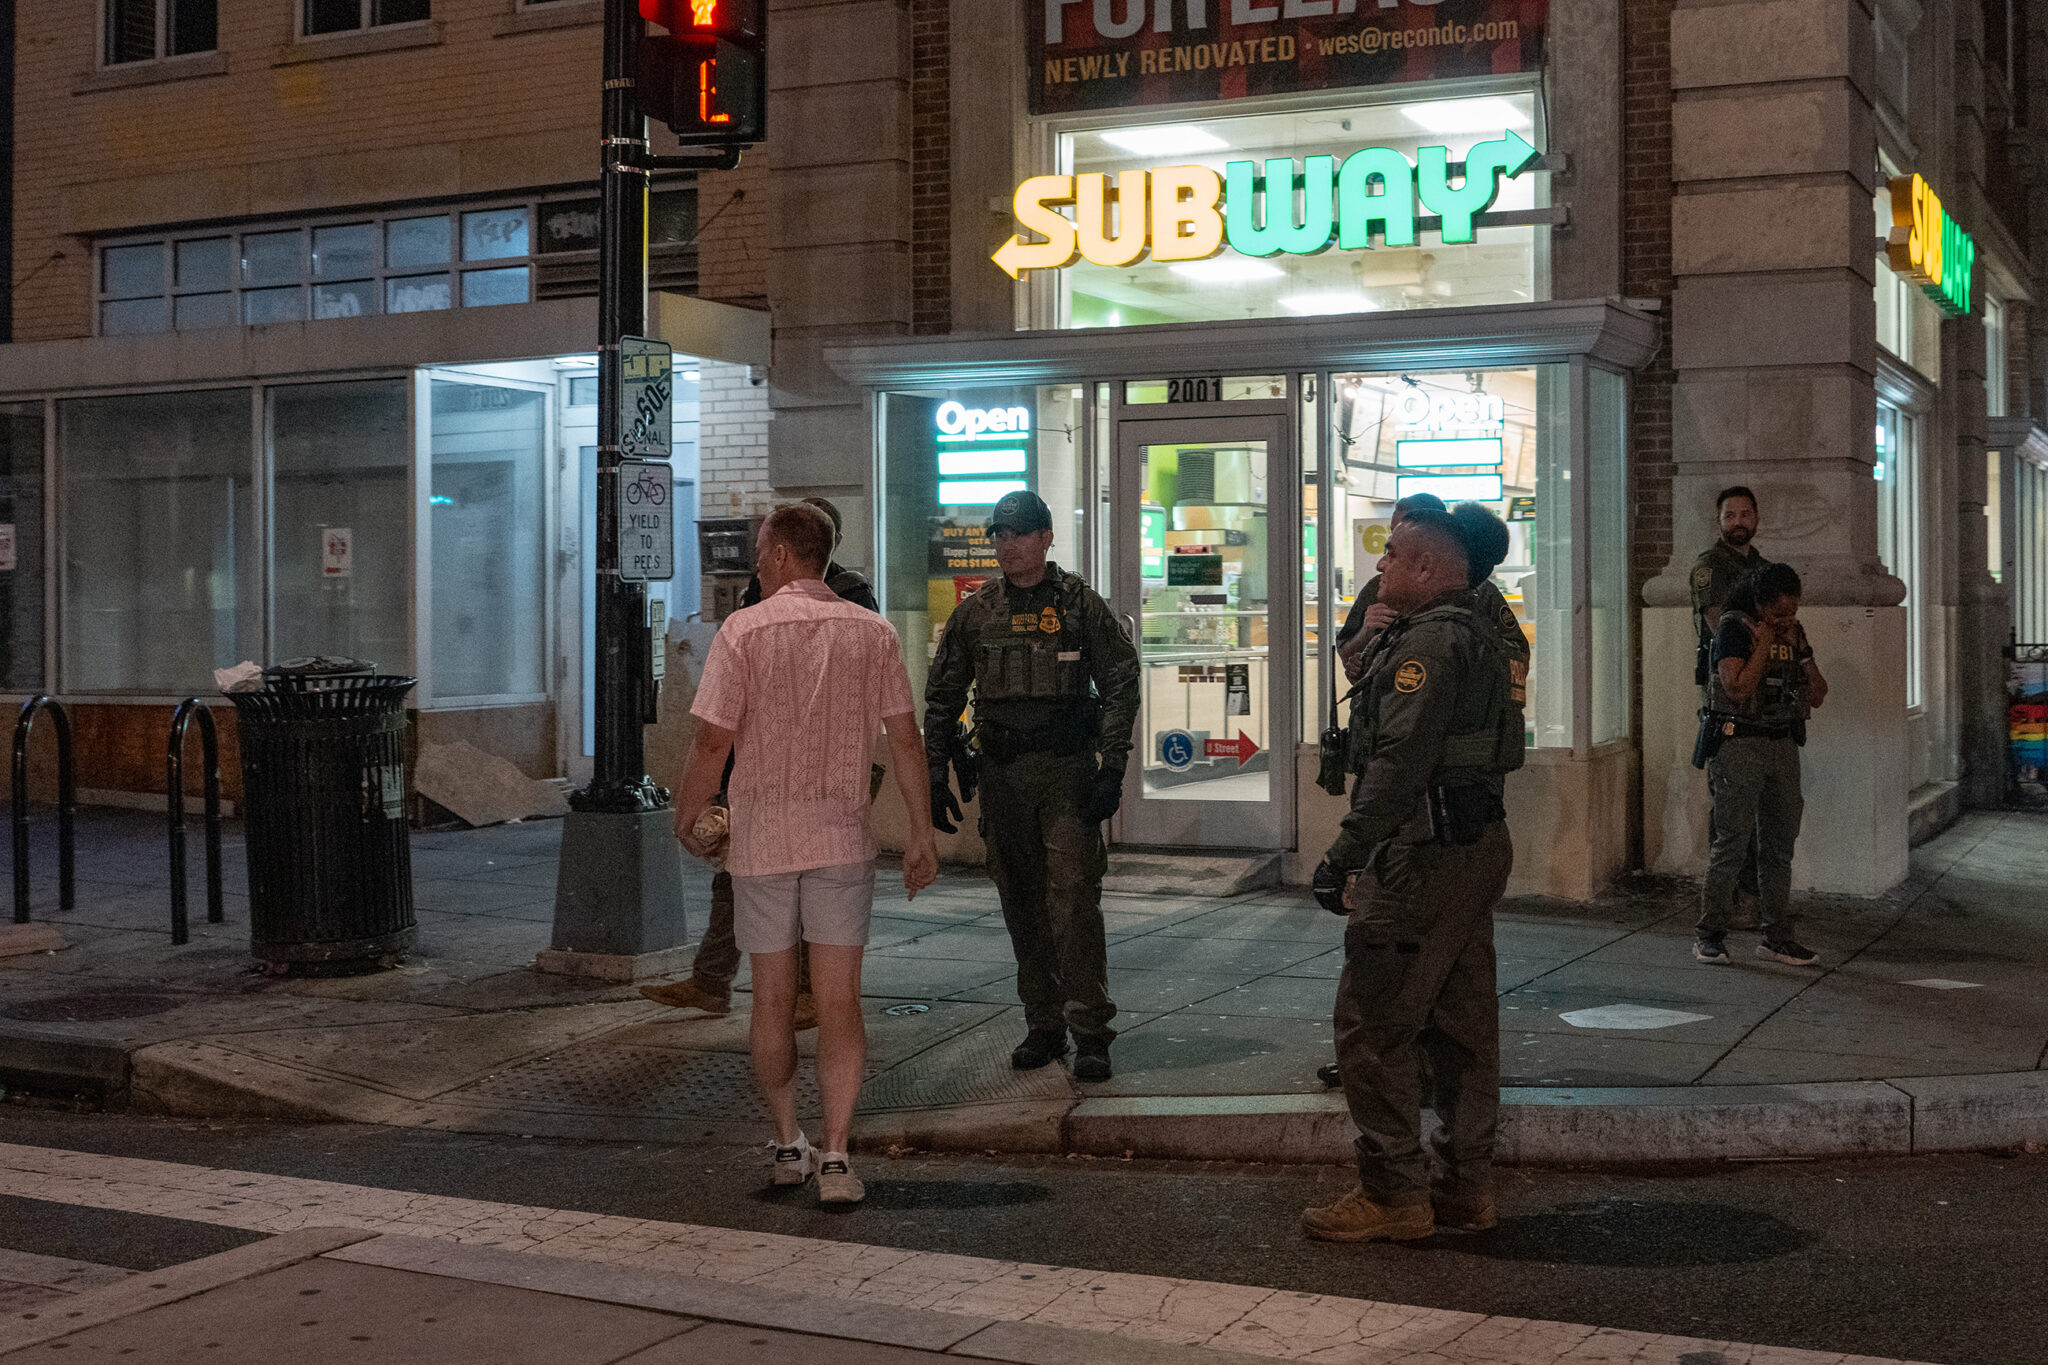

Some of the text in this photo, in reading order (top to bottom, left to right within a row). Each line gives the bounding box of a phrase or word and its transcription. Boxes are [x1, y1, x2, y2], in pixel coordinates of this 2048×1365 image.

[1045, 19, 1518, 84] NEWLY RENOVATED wes@recondc.com
[990, 128, 1537, 281] SUBWAY
[1168, 378, 1221, 402] 2001
[1398, 386, 1504, 430] Open
[936, 400, 1030, 441] Open
[629, 514, 660, 529] YIELD
[943, 527, 988, 537] BUY ANY
[640, 534, 653, 549] TO
[633, 554, 661, 570] PEDS
[948, 558, 968, 568] FOR
[1770, 644, 1794, 661] FBI
[1214, 742, 1240, 754] Street
